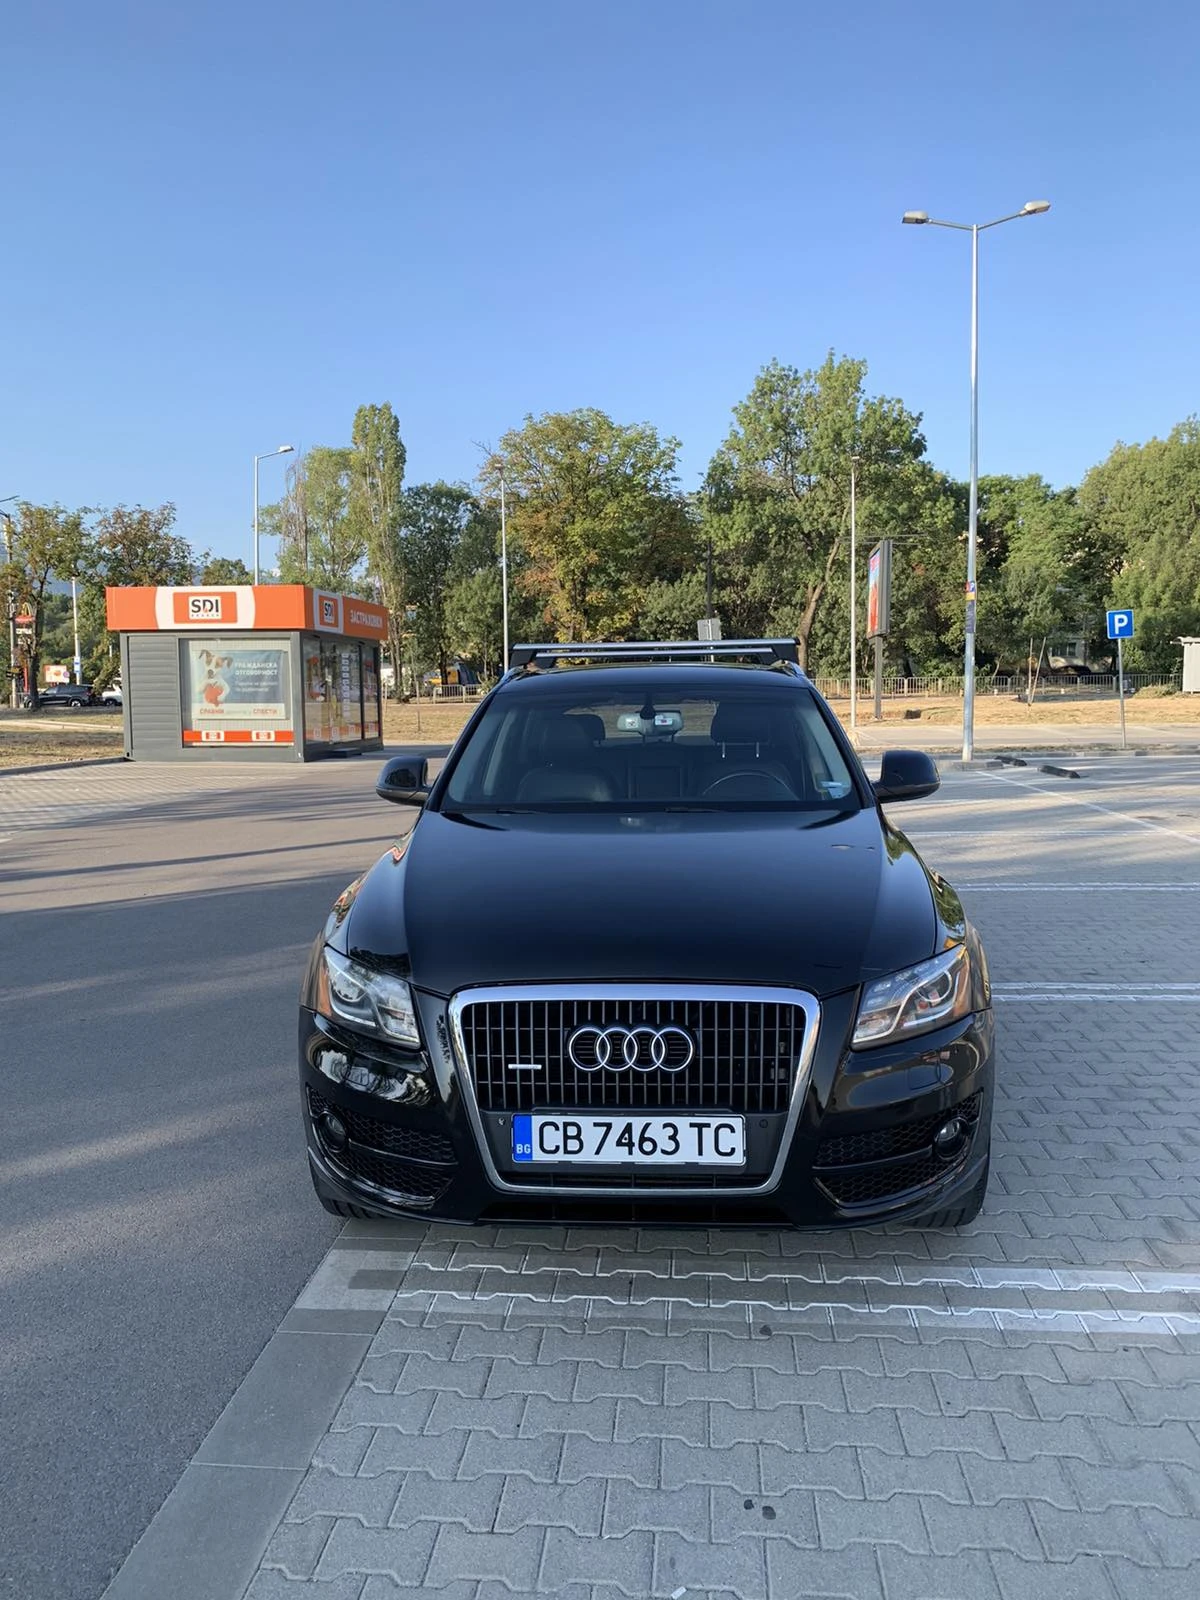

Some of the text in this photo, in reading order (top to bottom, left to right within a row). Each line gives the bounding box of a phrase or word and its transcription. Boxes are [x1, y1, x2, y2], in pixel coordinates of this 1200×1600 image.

[191, 598, 220, 614] SDI
[1114, 614, 1128, 635] P
[538, 1121, 736, 1157] CB 7463 TC
[516, 1144, 531, 1155] BG
